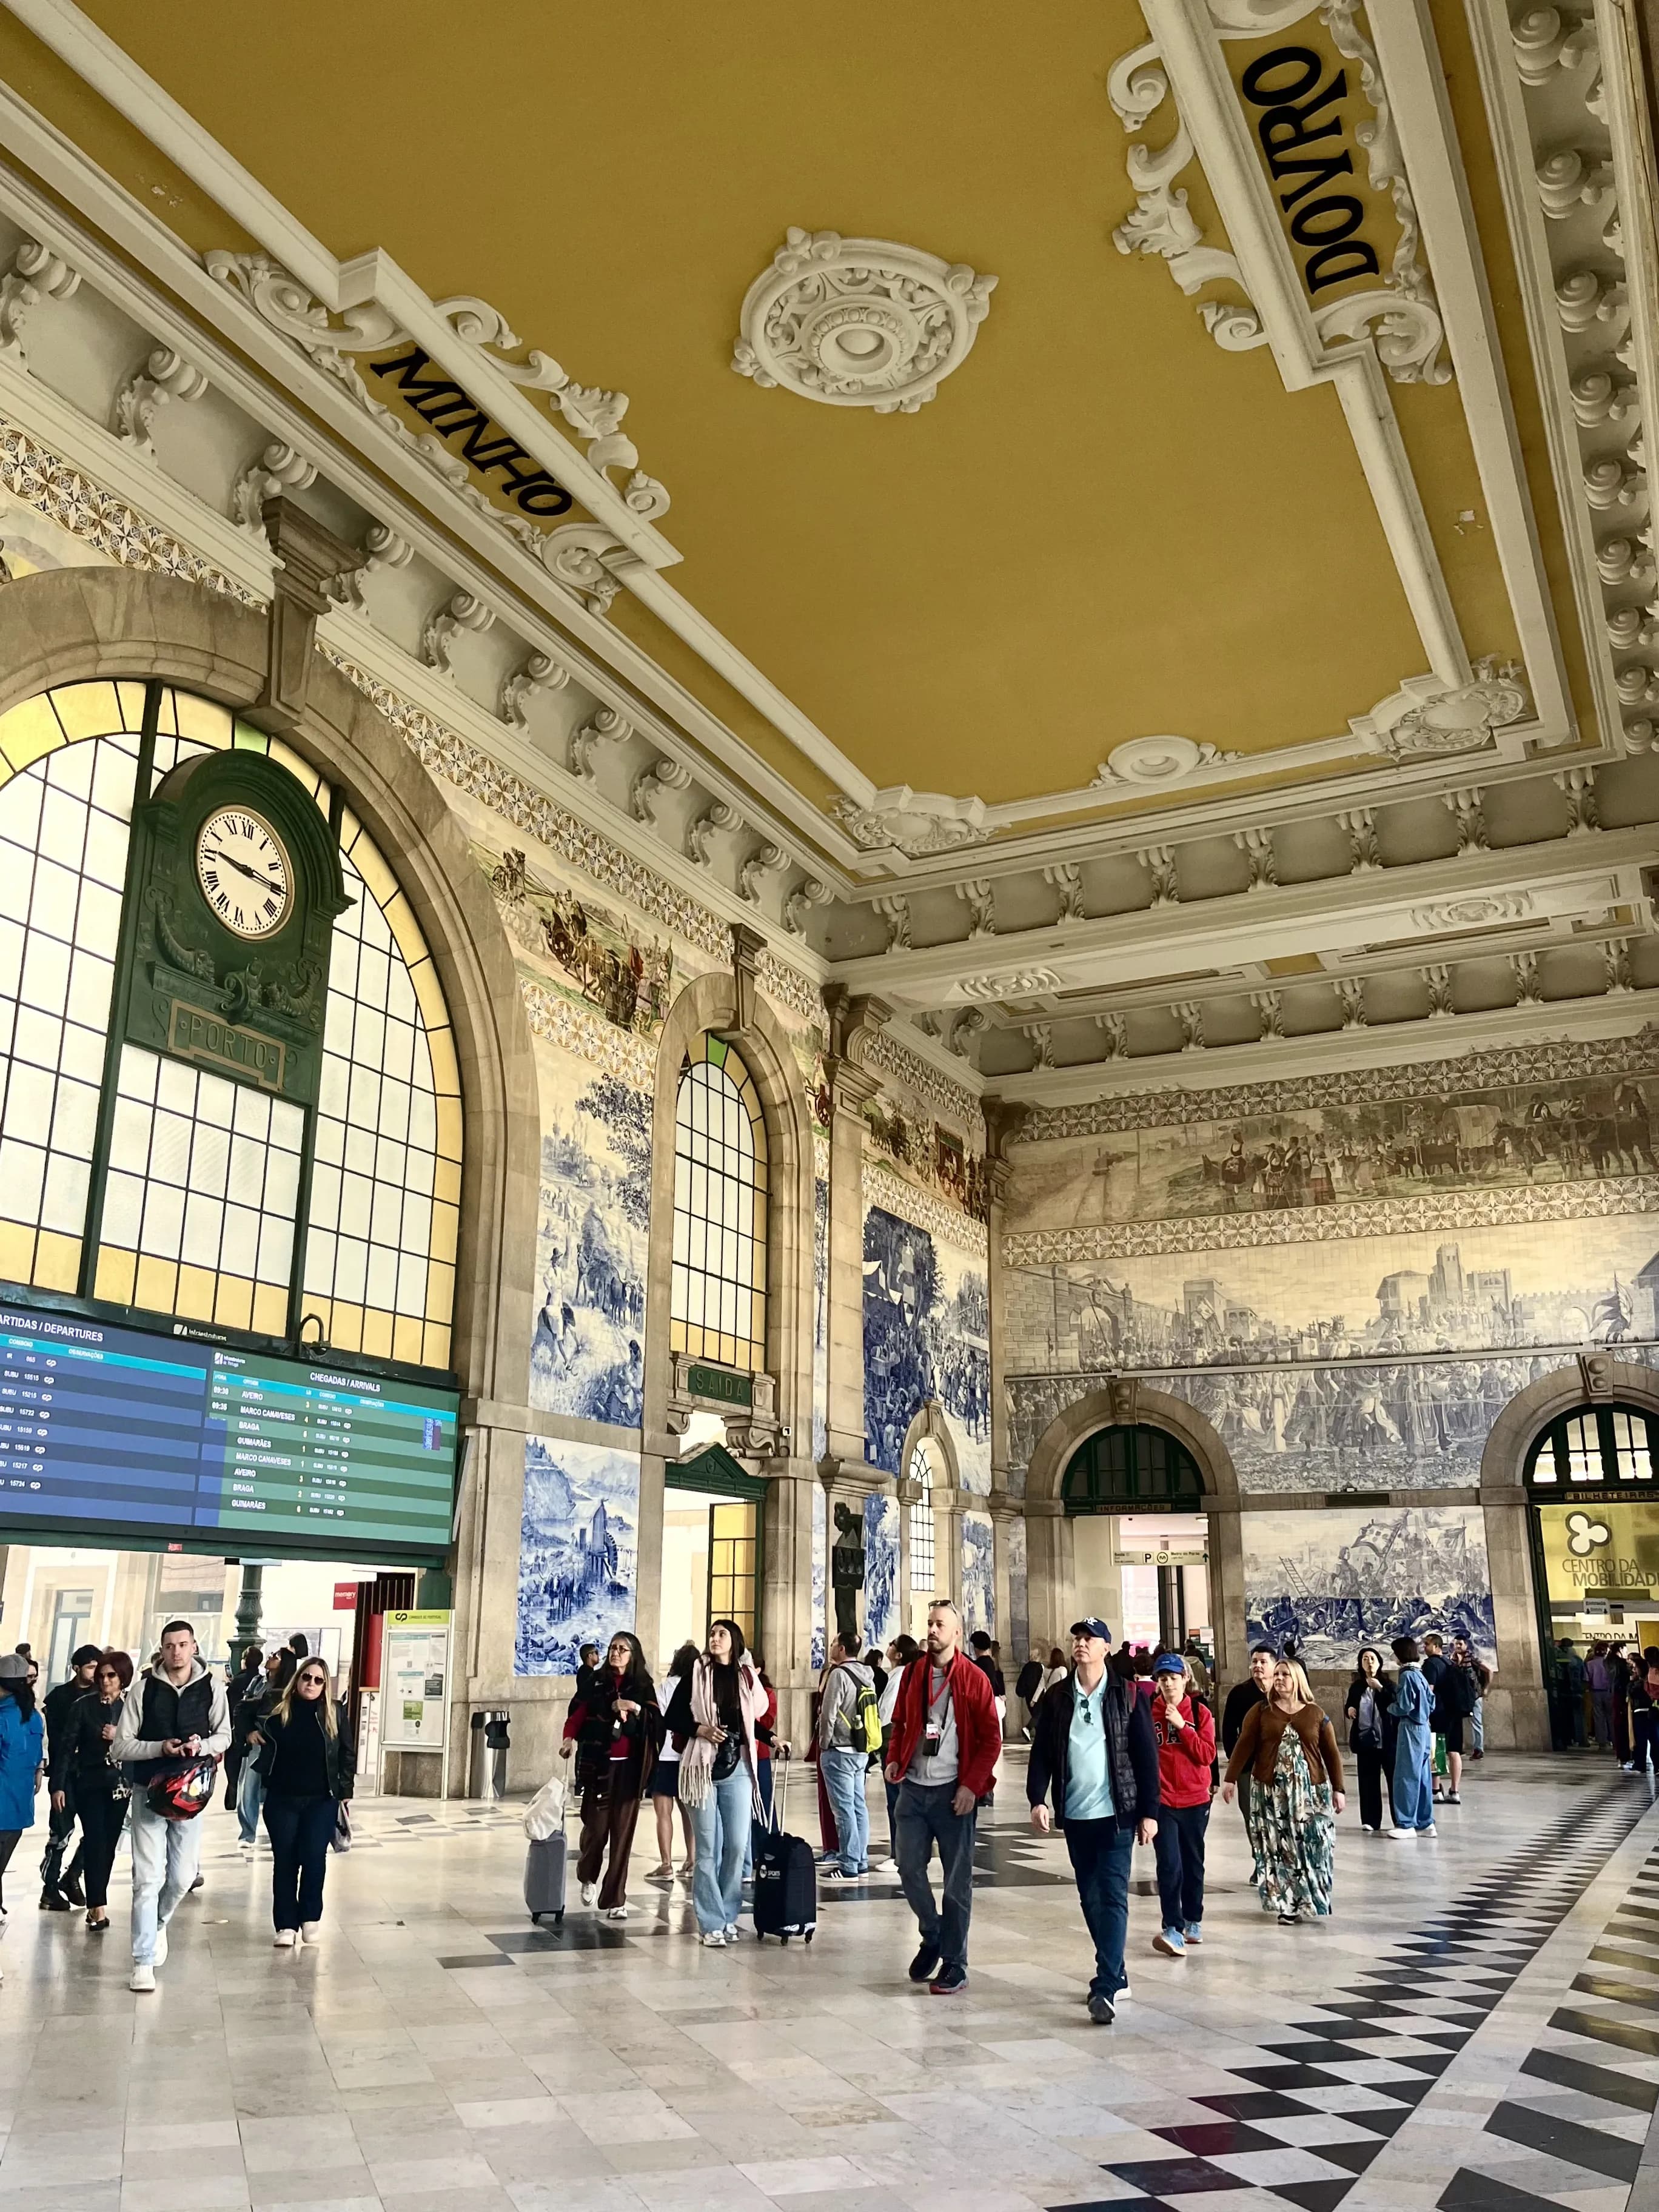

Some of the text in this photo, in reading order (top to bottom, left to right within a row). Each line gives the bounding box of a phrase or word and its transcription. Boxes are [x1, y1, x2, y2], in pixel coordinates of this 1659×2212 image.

[1242, 46, 1380, 295] DOVRO
[370, 347, 572, 516] MINHO
[189, 1014, 267, 1069] PORTO
[44, 1322, 103, 1342] DEPARTURES
[310, 1372, 346, 1387] CHEGADAS
[350, 1379, 381, 1392] ARRIVALS
[241, 1391, 264, 1401] AVEIRO
[240, 1406, 261, 1416] MARCO
[238, 1421, 260, 1431] BRAGA
[234, 1468, 256, 1478] AVEIRO
[233, 1483, 254, 1493] BRAGA
[1573, 1491, 1655, 1500] BILHETEIRAS
[1144, 1553, 1152, 1563] P
[1562, 1558, 1640, 1572] CENTRO DA
